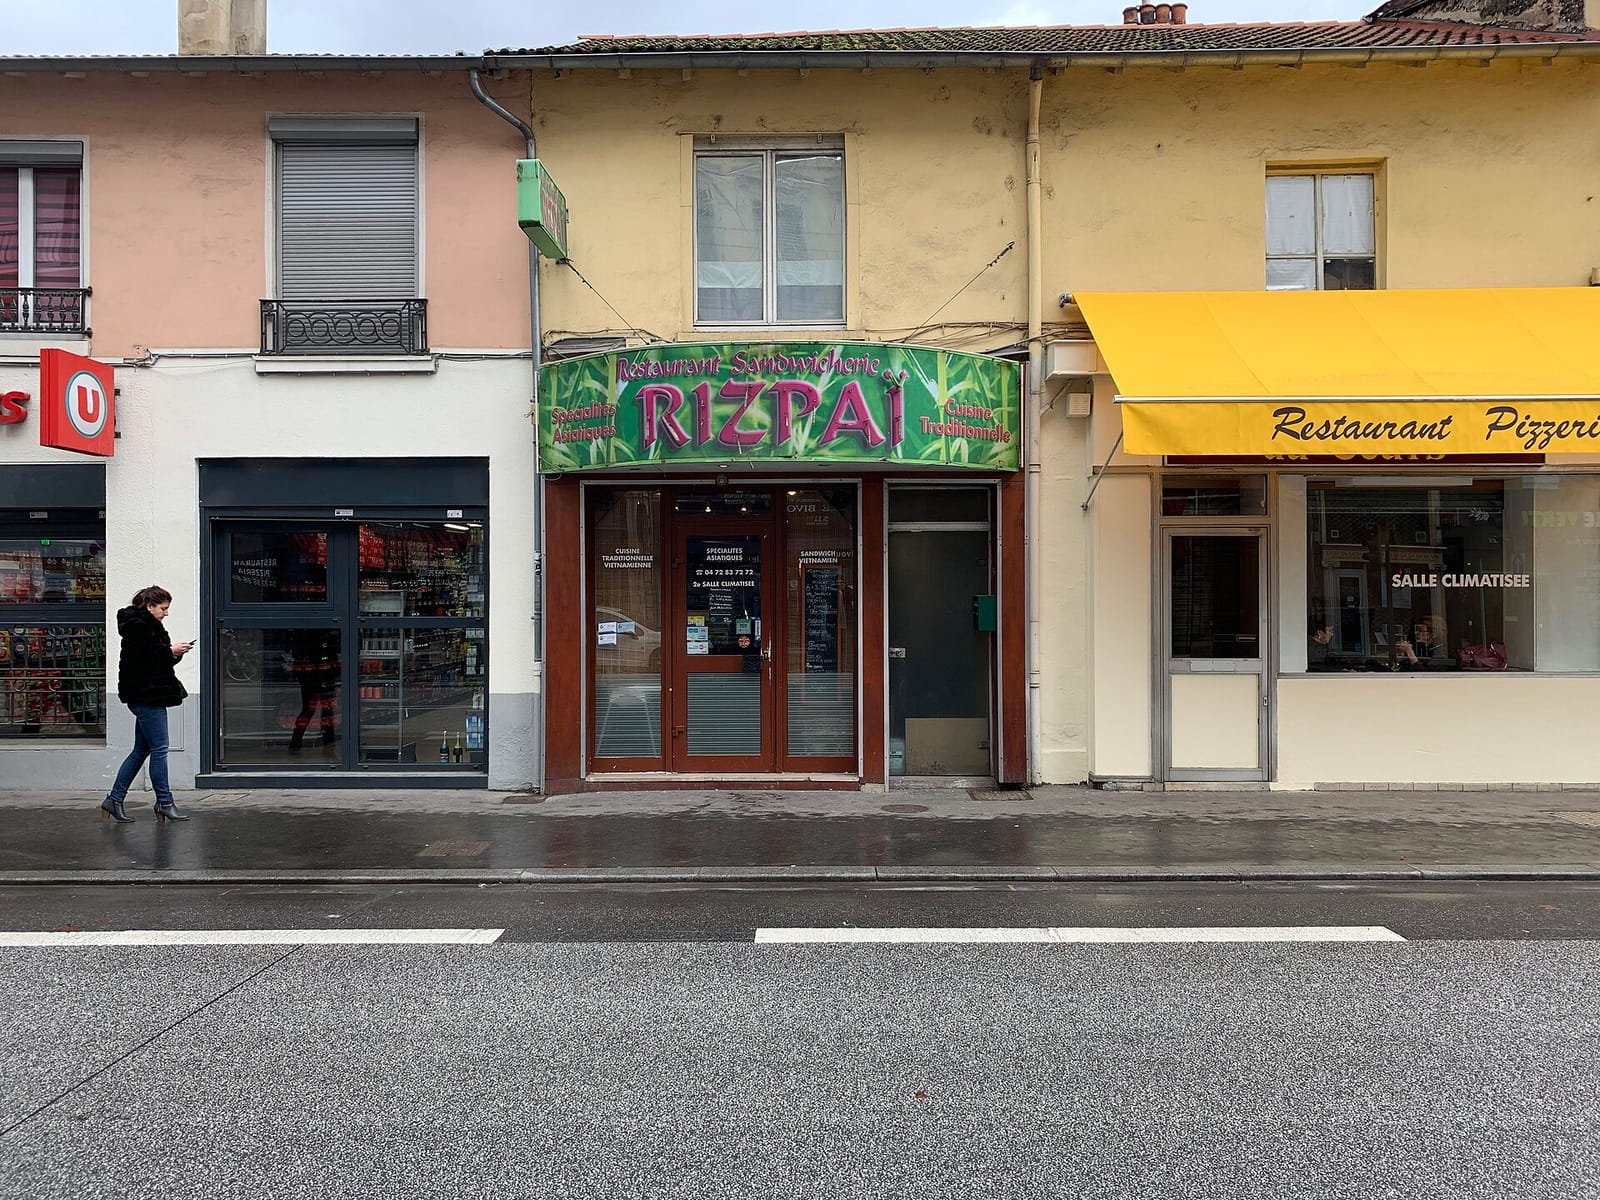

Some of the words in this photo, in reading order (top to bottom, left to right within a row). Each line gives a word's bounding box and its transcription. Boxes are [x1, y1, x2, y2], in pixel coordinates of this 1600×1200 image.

[617, 355, 722, 381] Restaurant
[731, 348, 880, 376] Sandwicherie
[0, 390, 31, 425] s
[77, 385, 100, 423] U
[944, 398, 993, 421] Cuisine
[552, 423, 617, 445] Asiatiques
[920, 416, 1012, 444] Traditionnelle
[1271, 406, 1453, 441] Restaurant
[702, 580, 720, 588] SALLE
[1392, 574, 1438, 587] SALLE
[1441, 574, 1530, 588] CLIMATISEE
